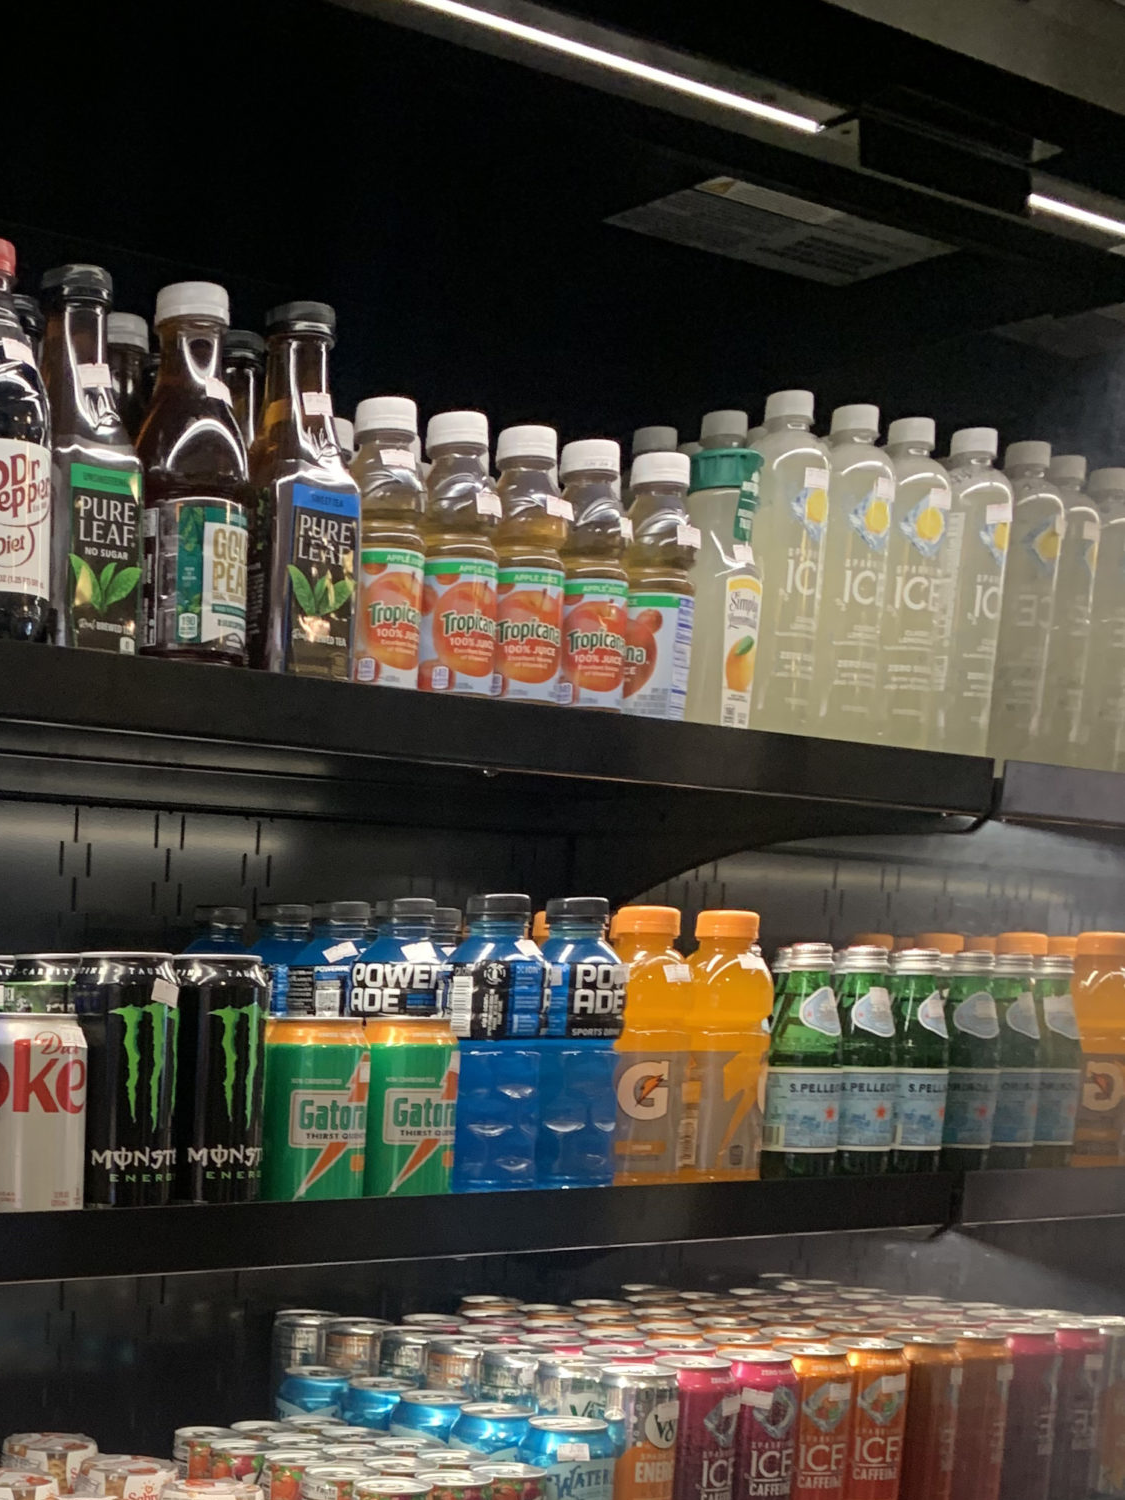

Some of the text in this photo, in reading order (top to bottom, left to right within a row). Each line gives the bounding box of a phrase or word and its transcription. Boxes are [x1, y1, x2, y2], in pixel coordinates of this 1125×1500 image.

[11, 453, 41, 483] Dr
[79, 496, 136, 525] PURE
[79, 519, 134, 547] LEAF
[299, 514, 352, 544] PURE
[85, 546, 128, 560] NO SUGAR
[212, 560, 247, 594] PEA
[514, 574, 559, 585] APPLE JUICE
[583, 585, 605, 594] APPLE
[786, 558, 817, 596] IC
[376, 628, 403, 639] 100%
[450, 636, 474, 647] 100%
[496, 617, 560, 646] Tropicana
[504, 645, 556, 657] 100% JUICE
[575, 654, 623, 665] 100% JUICE
[350, 987, 400, 1013] ADE
[575, 988, 624, 1014] ADE
[571, 1028, 601, 1037] SPORTS
[618, 1061, 669, 1120] G
[306, 1132, 339, 1140] THIRST
[400, 1129, 432, 1137] THIRST
[798, 1443, 846, 1472] ICE
[854, 1436, 901, 1464] ICE
[750, 1449, 793, 1478] ICE
